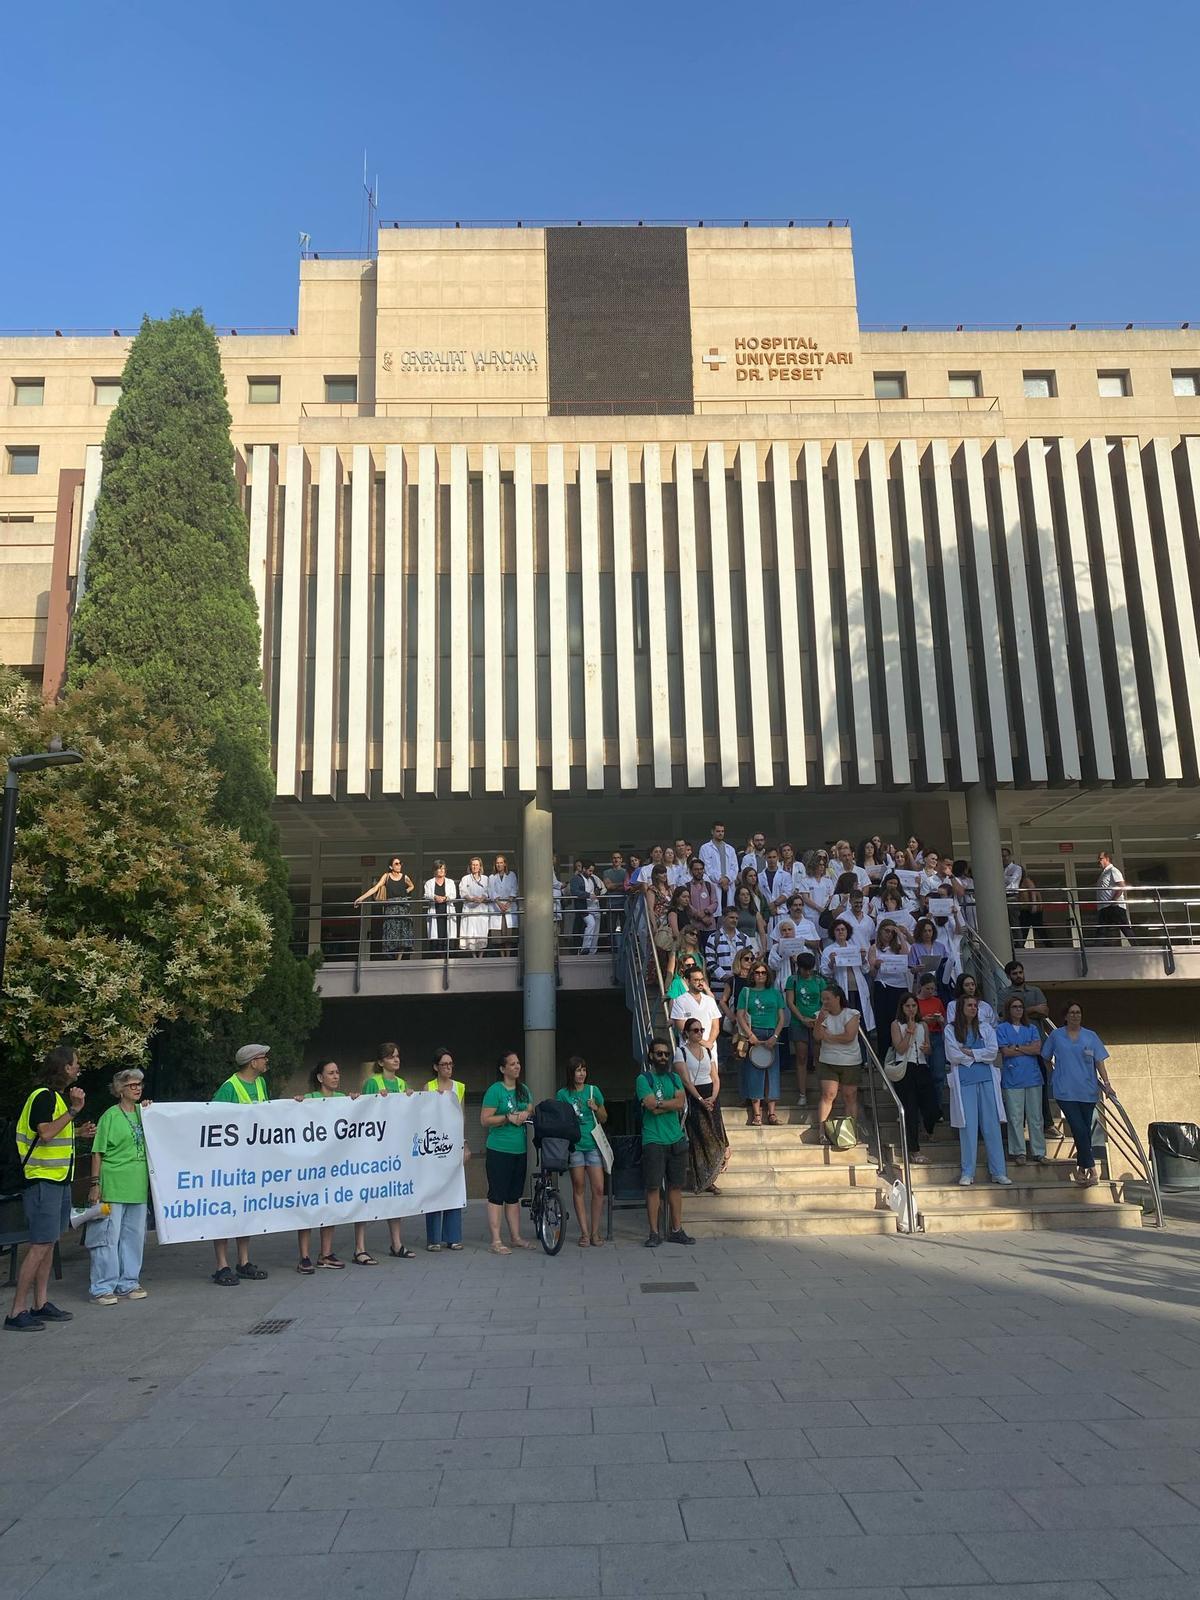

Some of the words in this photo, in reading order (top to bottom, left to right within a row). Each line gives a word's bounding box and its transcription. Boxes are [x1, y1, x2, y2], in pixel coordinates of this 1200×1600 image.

[735, 337, 815, 350] HOSPITAL
[400, 350, 467, 365] GENERALITAT
[471, 350, 538, 365] VALENCIANA
[735, 352, 853, 365] UNIVERSITARI
[736, 368, 764, 382] DR.
[769, 367, 824, 381] PESET
[200, 1123, 239, 1148] IES
[246, 1122, 296, 1146] Juan
[302, 1120, 328, 1143] de
[333, 1118, 387, 1142] Garay
[177, 1171, 204, 1190] En
[211, 1168, 256, 1188] lluita
[261, 1168, 292, 1188] per
[297, 1165, 327, 1182] una
[330, 1154, 402, 1178] educació
[243, 1191, 319, 1213] inclusiva
[324, 1187, 329, 1205] i
[334, 1185, 354, 1204] de
[359, 1179, 414, 1204] qualitat
